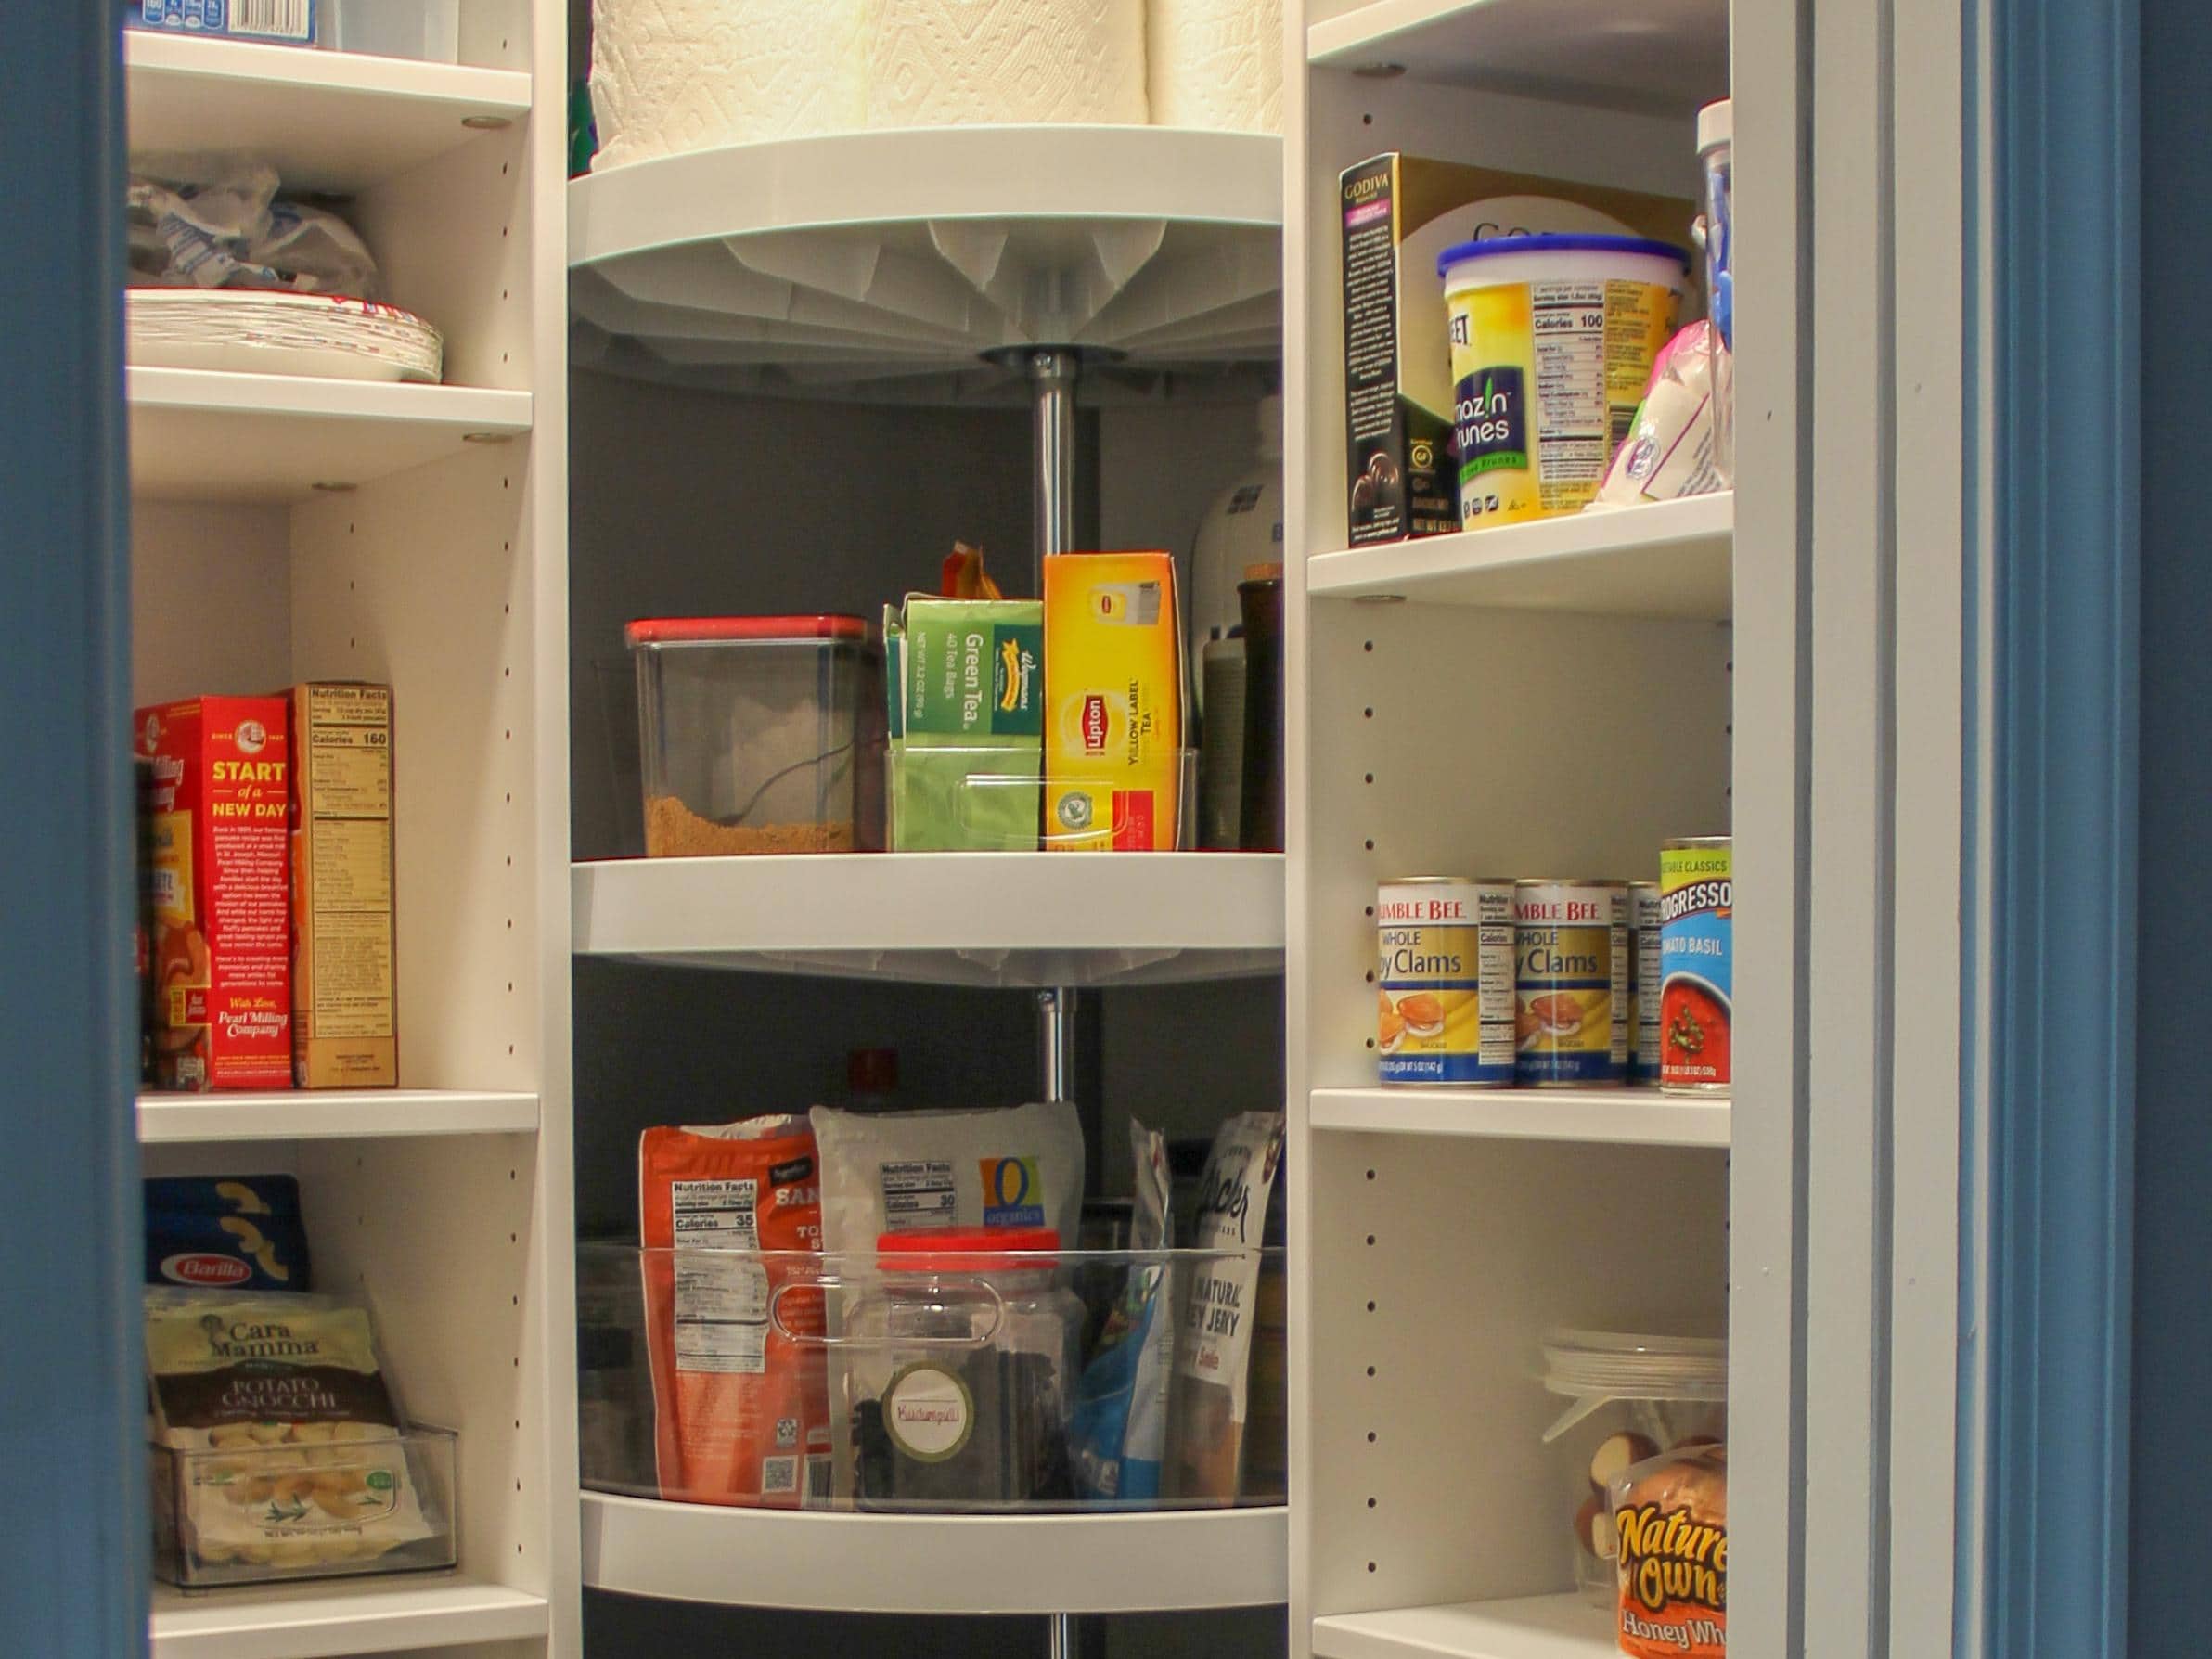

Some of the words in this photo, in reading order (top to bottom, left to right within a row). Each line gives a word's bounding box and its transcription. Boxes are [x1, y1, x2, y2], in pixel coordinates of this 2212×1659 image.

[1345, 173, 1388, 199] GODIVA
[1535, 319, 1573, 329] Calories
[1581, 314, 1603, 328] 100
[946, 633, 958, 648] 40
[946, 650, 958, 669] Tea
[965, 633, 984, 688] Green
[312, 688, 357, 699] Nutrition
[359, 689, 387, 699] Facts
[944, 671, 958, 699] Bags
[964, 689, 983, 721] Tea
[1128, 680, 1139, 717] LABEL
[1087, 700, 1104, 748] Lipton
[1141, 713, 1151, 735] TEA
[312, 733, 353, 744] Calories
[363, 732, 386, 745] 160
[1128, 718, 1139, 765] YELLOW
[212, 761, 286, 781] START
[238, 784, 252, 800] of
[252, 788, 262, 797] a
[212, 803, 251, 817] NEW
[255, 803, 287, 817] DAY
[1684, 860, 1727, 872] CLASSICS
[1429, 899, 1467, 920] BEE
[1567, 901, 1601, 920] BEE
[1382, 931, 1421, 945] WHOLE
[1688, 937, 1723, 956] BASIL
[1395, 948, 1461, 974] Clams
[1528, 947, 1598, 974] Clams
[229, 997, 251, 1009] With
[218, 1011, 248, 1024] Pearl
[249, 1011, 289, 1029] Milling
[226, 1023, 279, 1038] Company
[882, 1163, 924, 1174] Nutrition
[926, 1162, 951, 1172] Facts
[675, 1182, 722, 1192] Nutrition
[725, 1181, 754, 1191] Facts
[676, 1219, 718, 1228] Calories
[735, 1215, 753, 1226] 35
[986, 1210, 1041, 1225] organics
[183, 1261, 246, 1278] Barilla
[230, 1321, 292, 1341] Cara
[211, 1339, 320, 1358] Mamma
[232, 1377, 320, 1393] POTATO
[222, 1393, 337, 1408] GNOCCHI
[1616, 1506, 1727, 1572] Nature
[1640, 1557, 1719, 1608] Own
[1623, 1610, 1690, 1649] Honey
[1687, 1619, 1726, 1645] Wh
